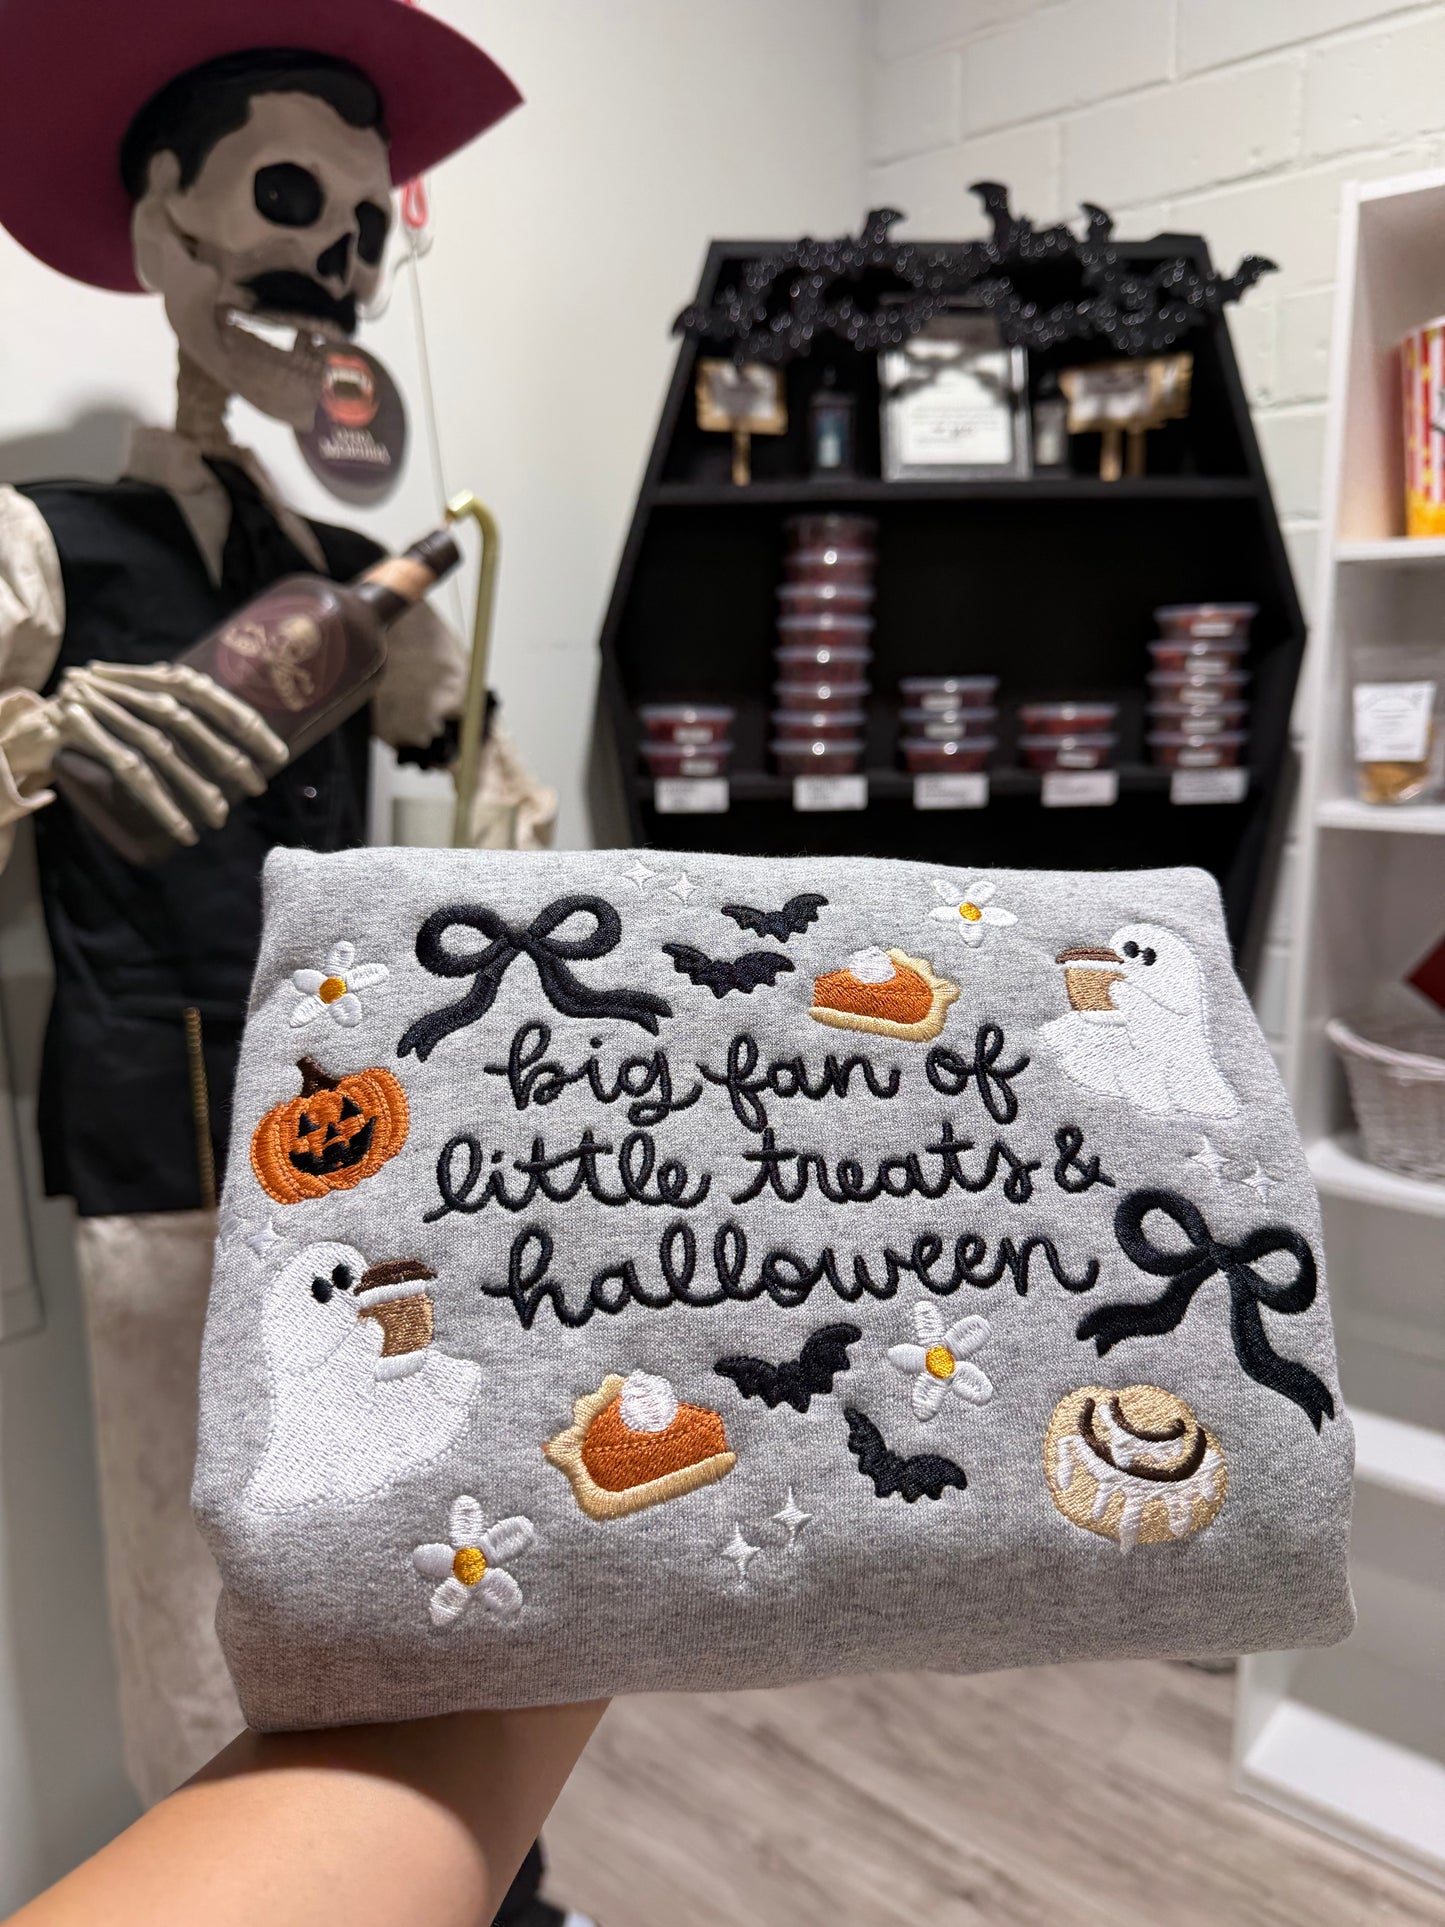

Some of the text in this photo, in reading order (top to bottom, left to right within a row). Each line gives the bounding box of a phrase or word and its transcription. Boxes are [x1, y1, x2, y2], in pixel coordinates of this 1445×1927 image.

[485, 1020, 1030, 1131] big fan of
[423, 1122, 1115, 1223] little treats &
[482, 1221, 1099, 1329] halloween
